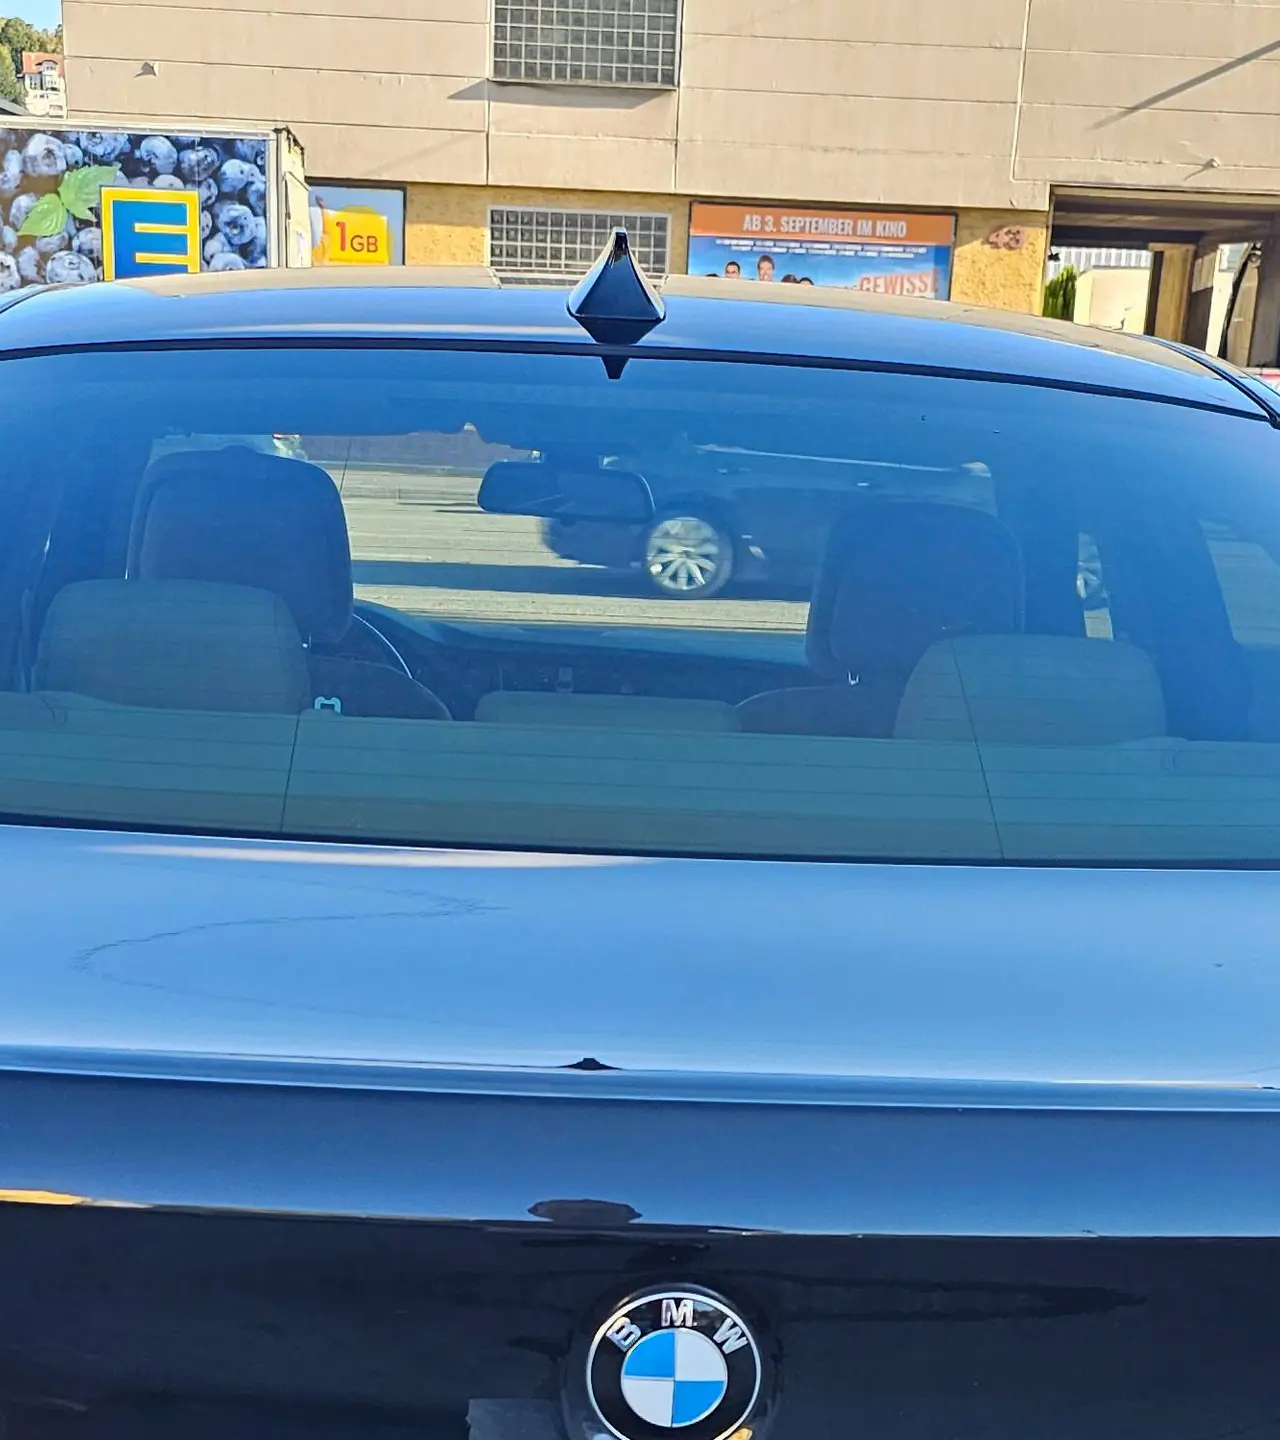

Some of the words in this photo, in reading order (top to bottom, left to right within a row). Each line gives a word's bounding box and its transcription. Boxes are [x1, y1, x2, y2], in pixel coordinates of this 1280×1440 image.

[336, 221, 346, 252] 1
[350, 234, 378, 253] GB
[743, 213, 761, 232] AB
[764, 215, 777, 233] 3.
[780, 216, 853, 236] SEPTEMBER
[857, 219, 872, 236] IM
[876, 220, 907, 238] KINO
[605, 1298, 749, 1354] BMW
